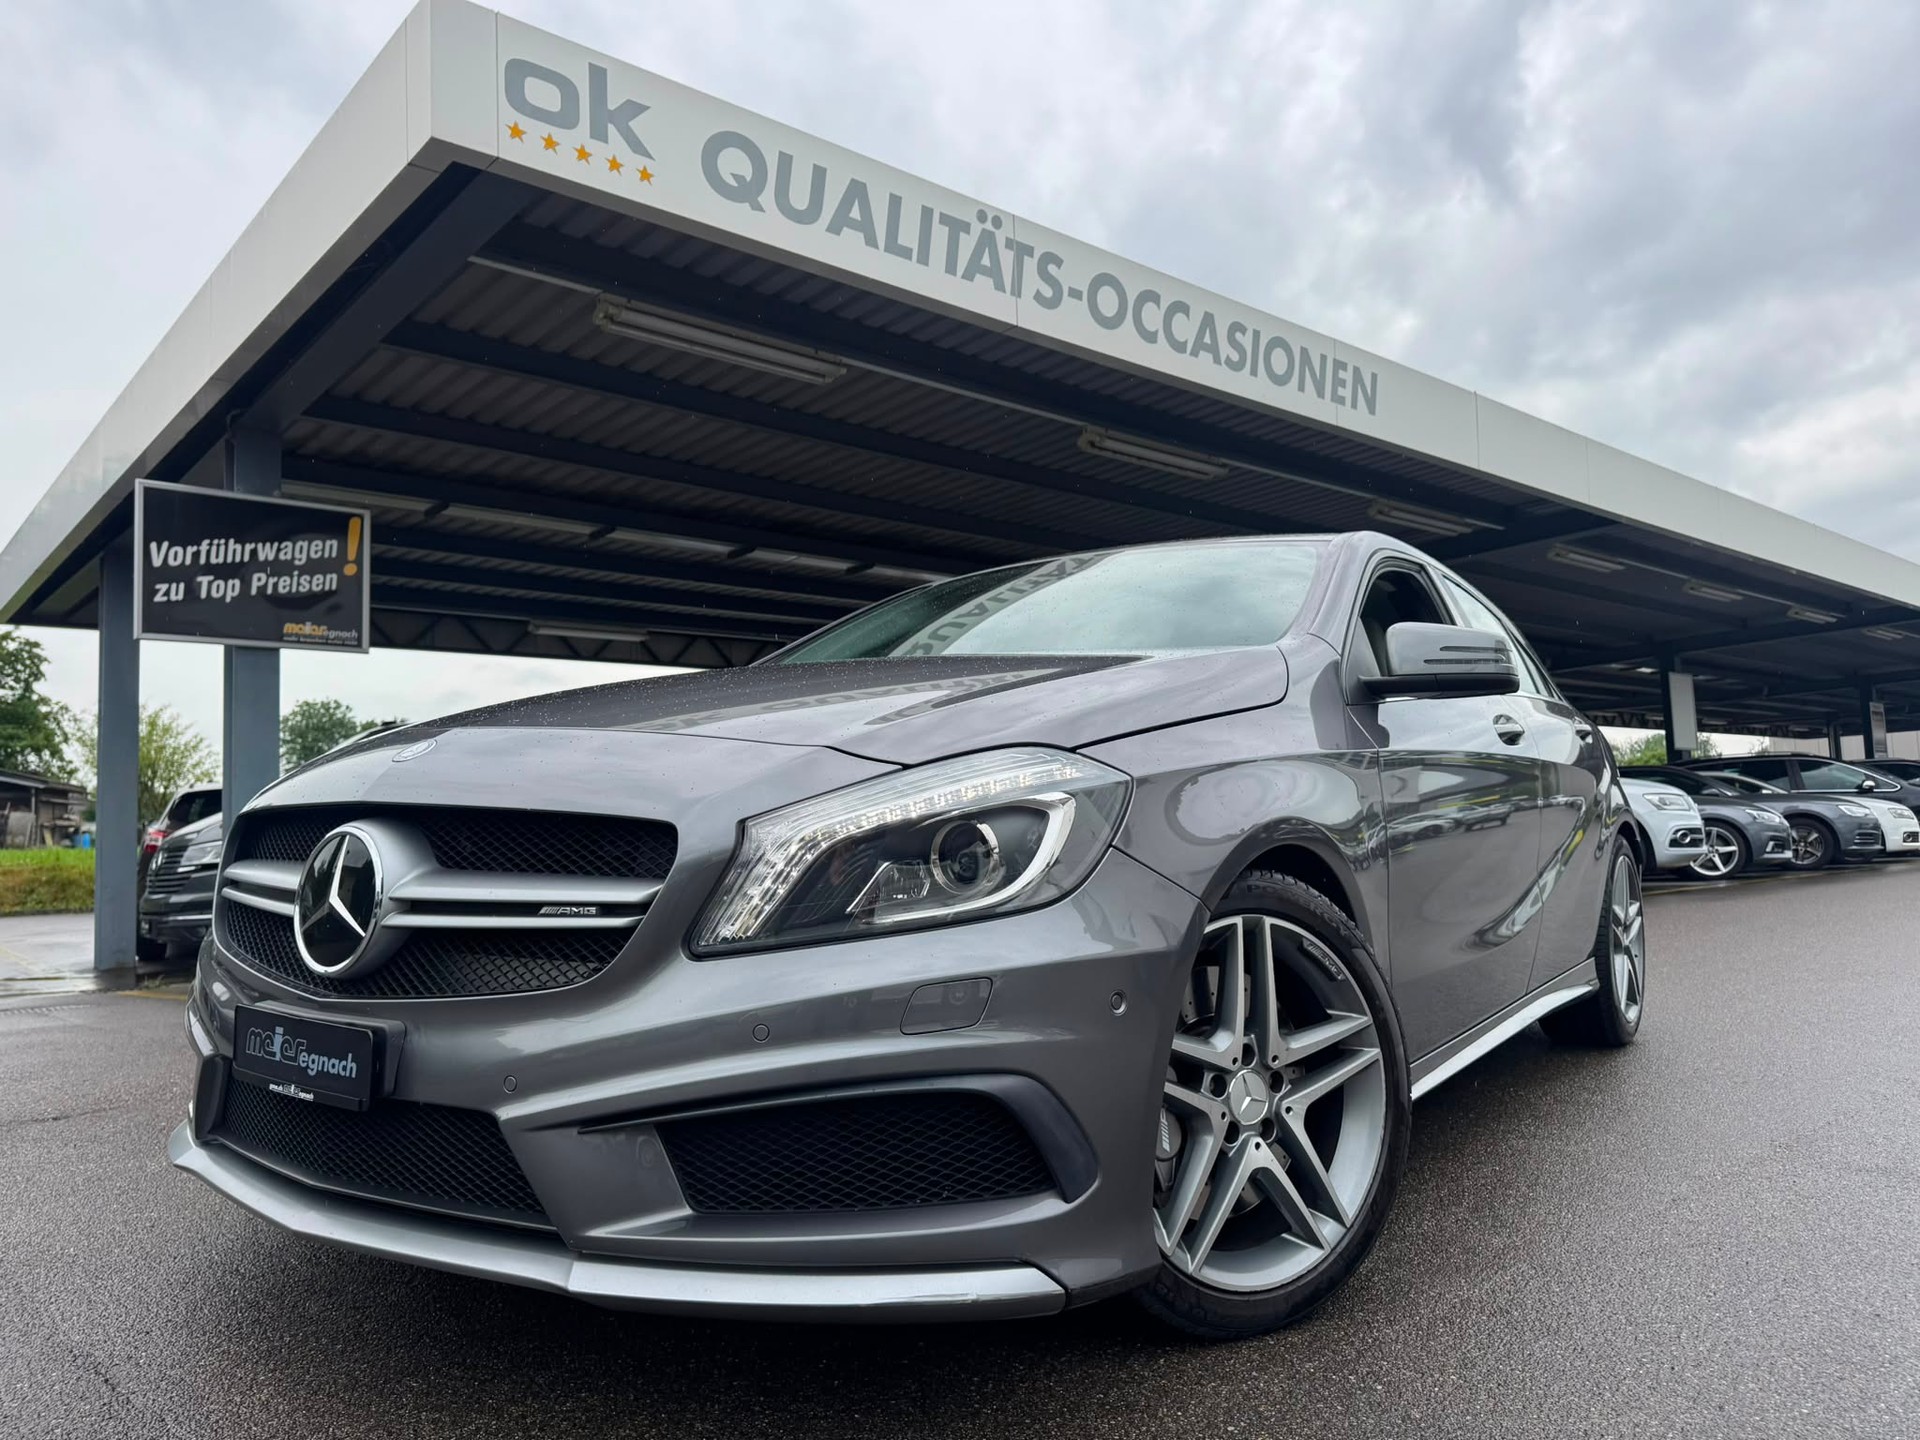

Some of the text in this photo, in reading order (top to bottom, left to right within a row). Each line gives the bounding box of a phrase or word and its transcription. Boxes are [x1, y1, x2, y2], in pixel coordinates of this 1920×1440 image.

[504, 58, 1378, 416] ok QUALITÄTS-OCCASIONEN
[149, 538, 338, 568] Vorführwagen
[153, 570, 338, 603] zu Top Preisen
[299, 1051, 358, 1078] egnach
